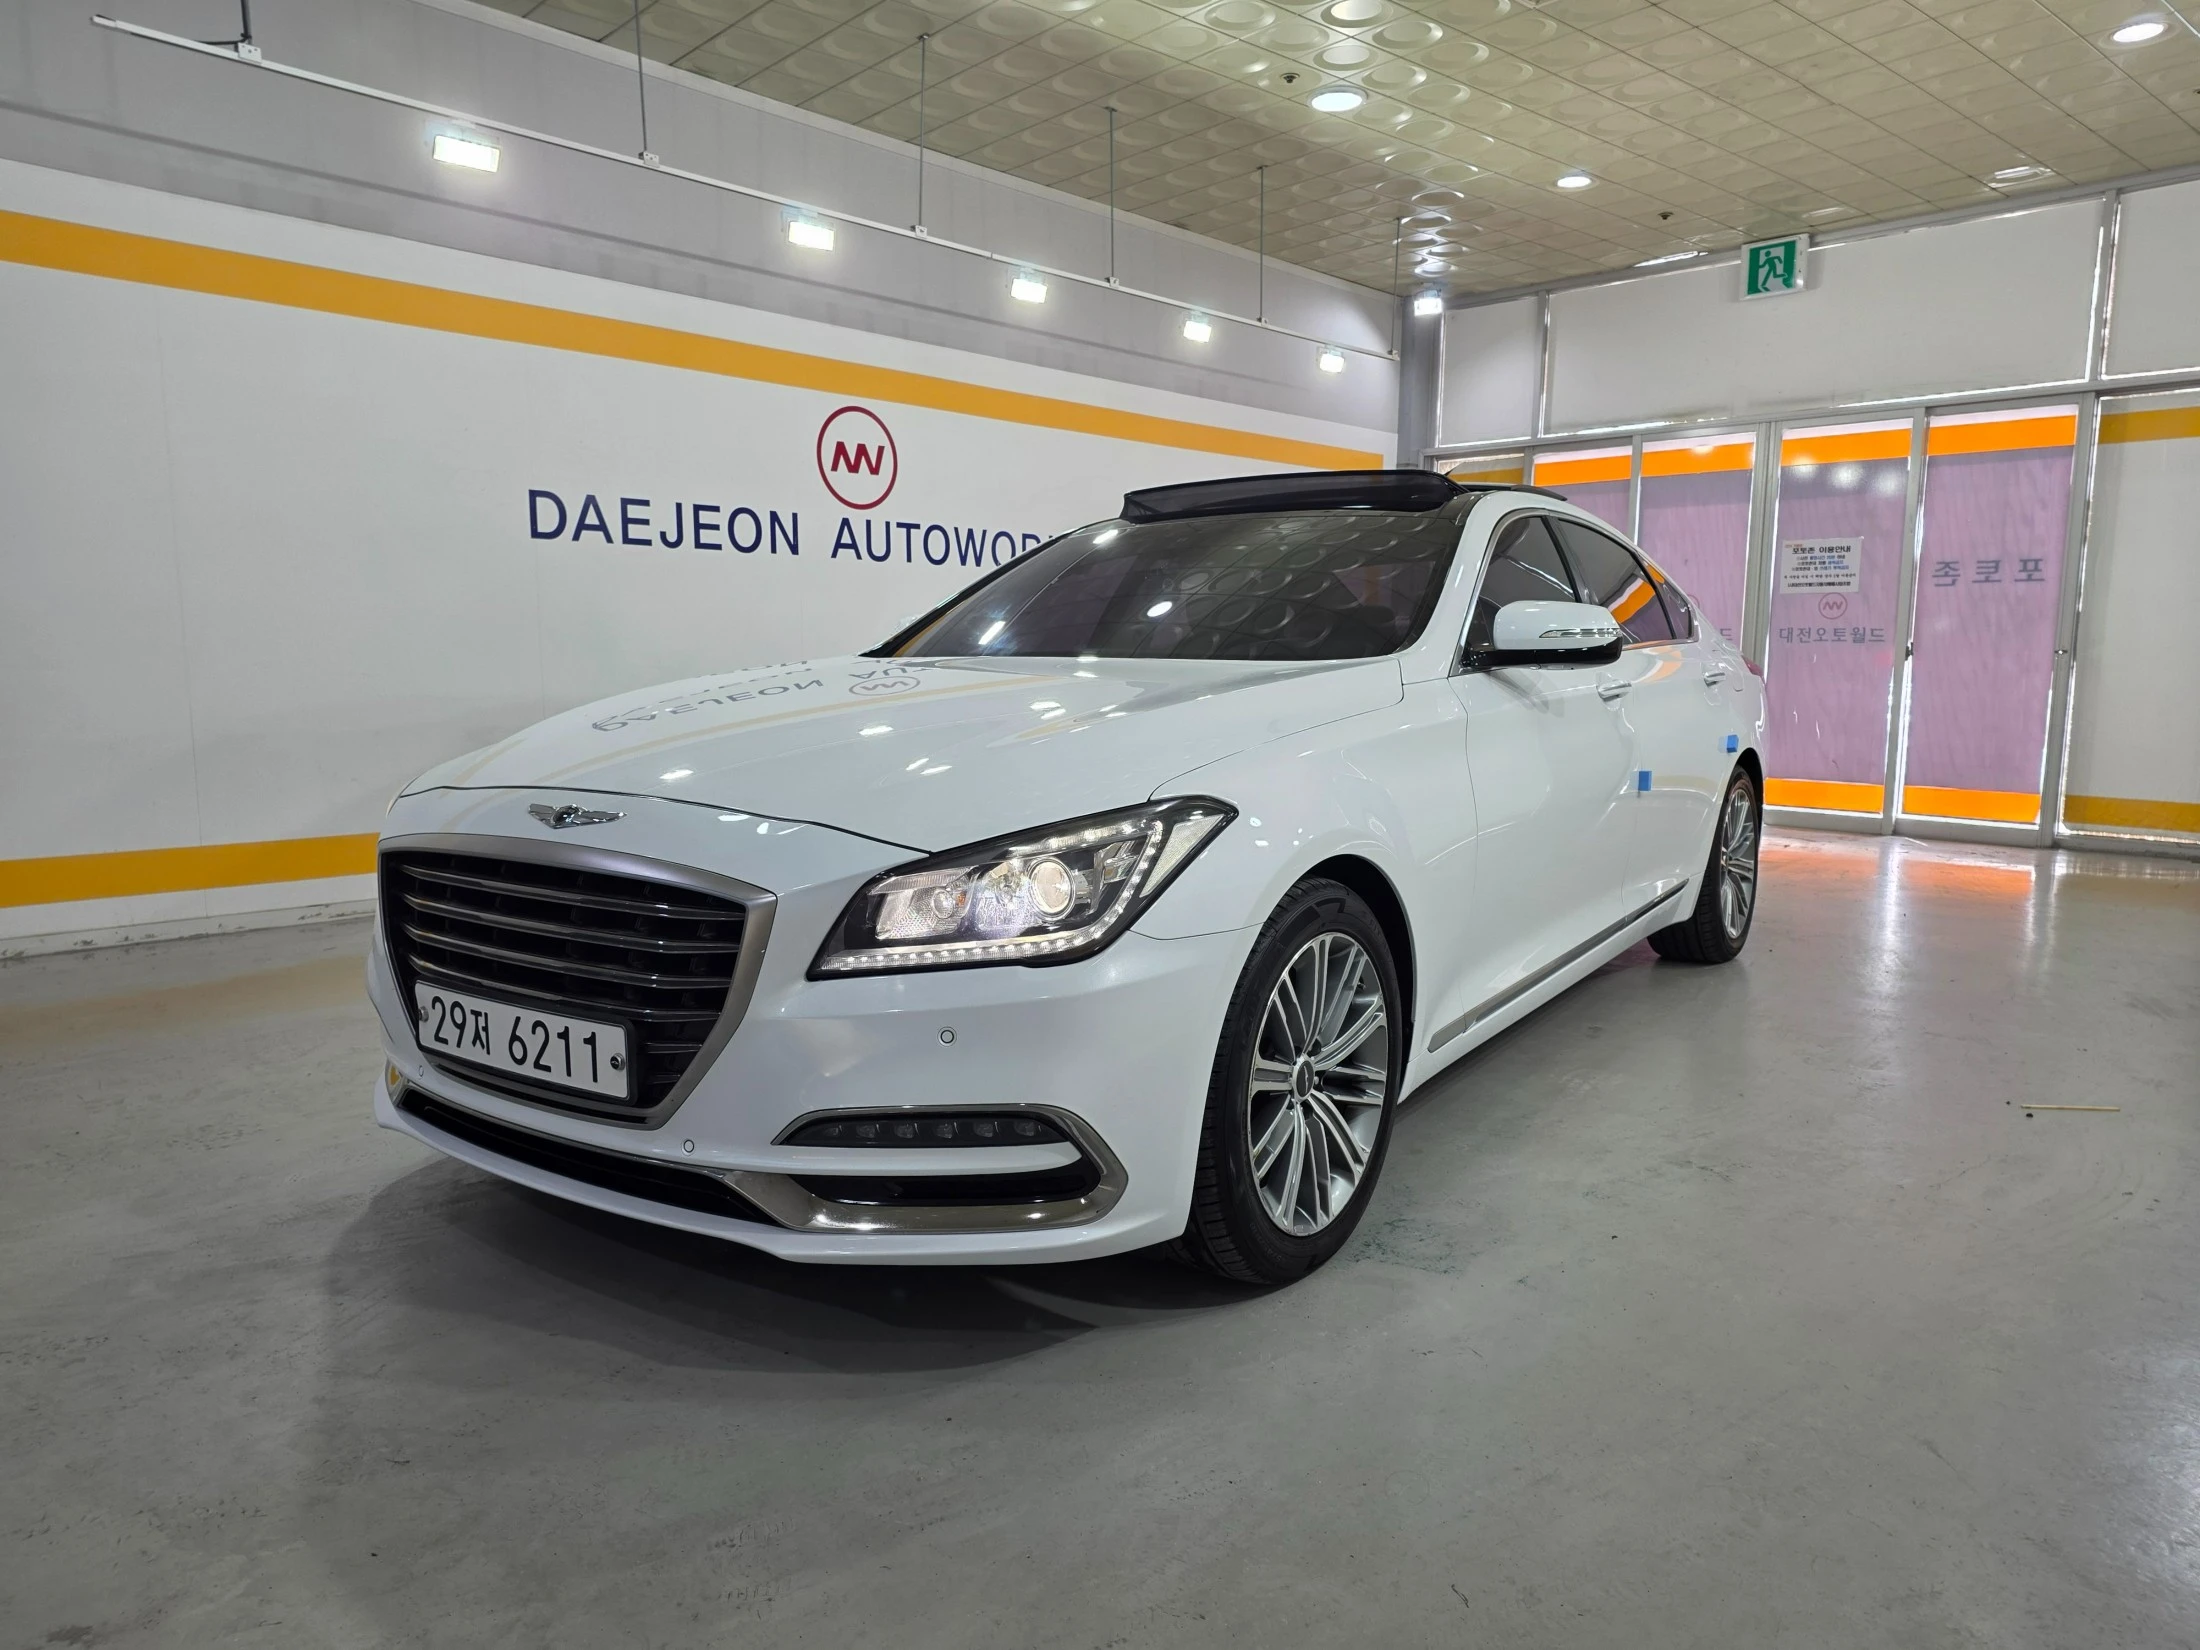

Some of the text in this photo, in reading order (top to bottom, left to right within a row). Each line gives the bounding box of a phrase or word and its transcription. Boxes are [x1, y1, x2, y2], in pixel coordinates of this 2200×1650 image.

[528, 489, 1053, 567] DAEJEON AUTOWO
[1819, 545, 1851, 553] 이용안내
[1779, 627, 1885, 643] 대전오토월드
[431, 996, 599, 1083] 29저 6211
